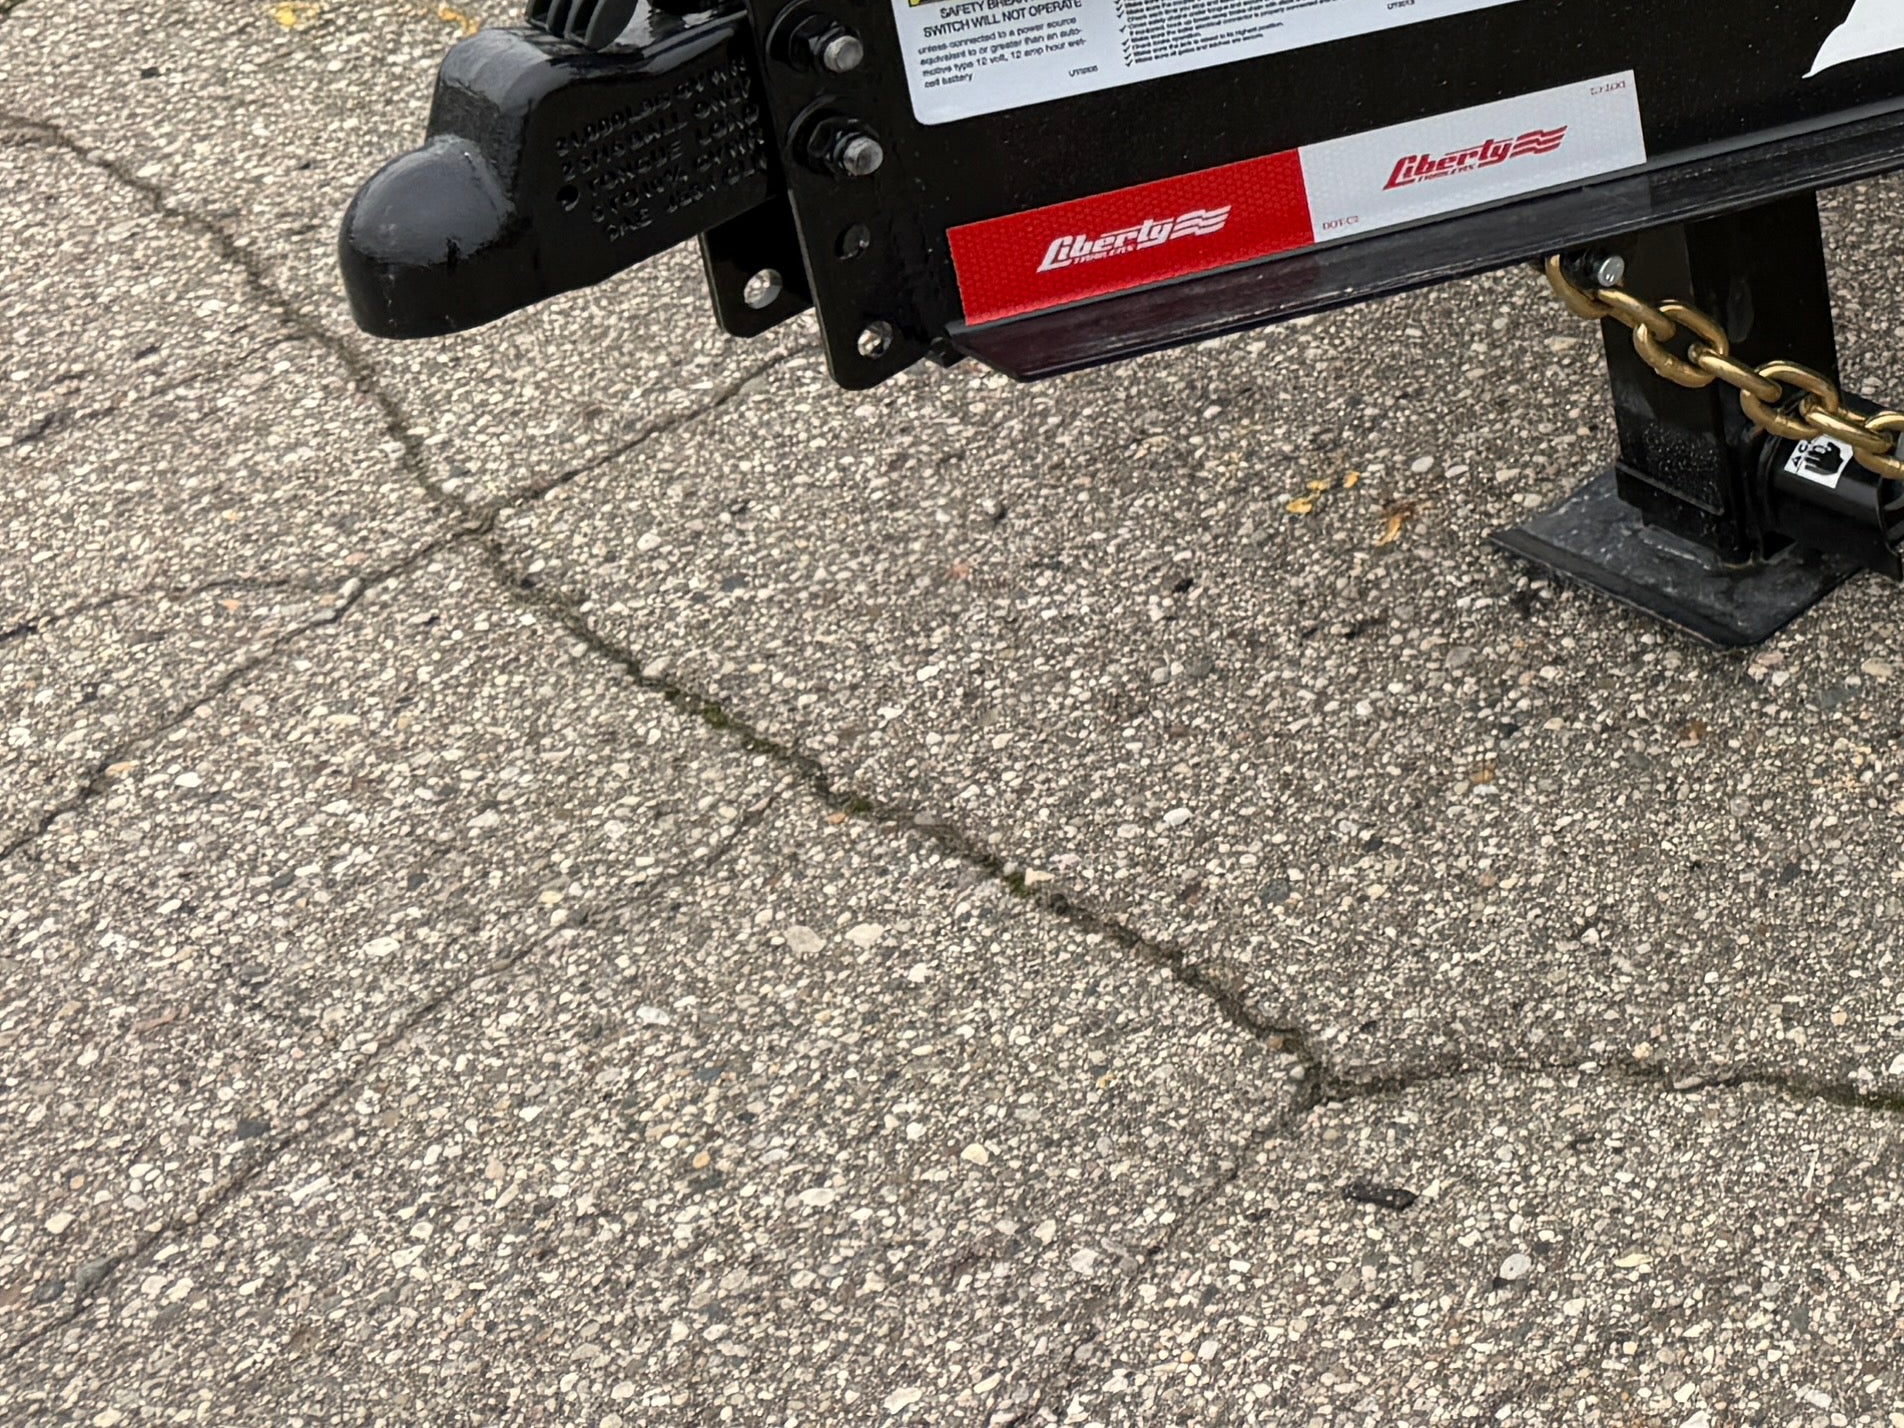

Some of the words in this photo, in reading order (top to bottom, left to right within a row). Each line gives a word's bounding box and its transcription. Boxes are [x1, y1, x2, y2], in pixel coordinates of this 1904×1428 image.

[923, 19, 970, 38] SWITCH
[972, 14, 1000, 28] WILL
[1002, 8, 1026, 21] NOT
[940, 1, 985, 18] SAFETY
[1382, 137, 1515, 191] Liberty
[1036, 217, 1174, 273] Liberty
